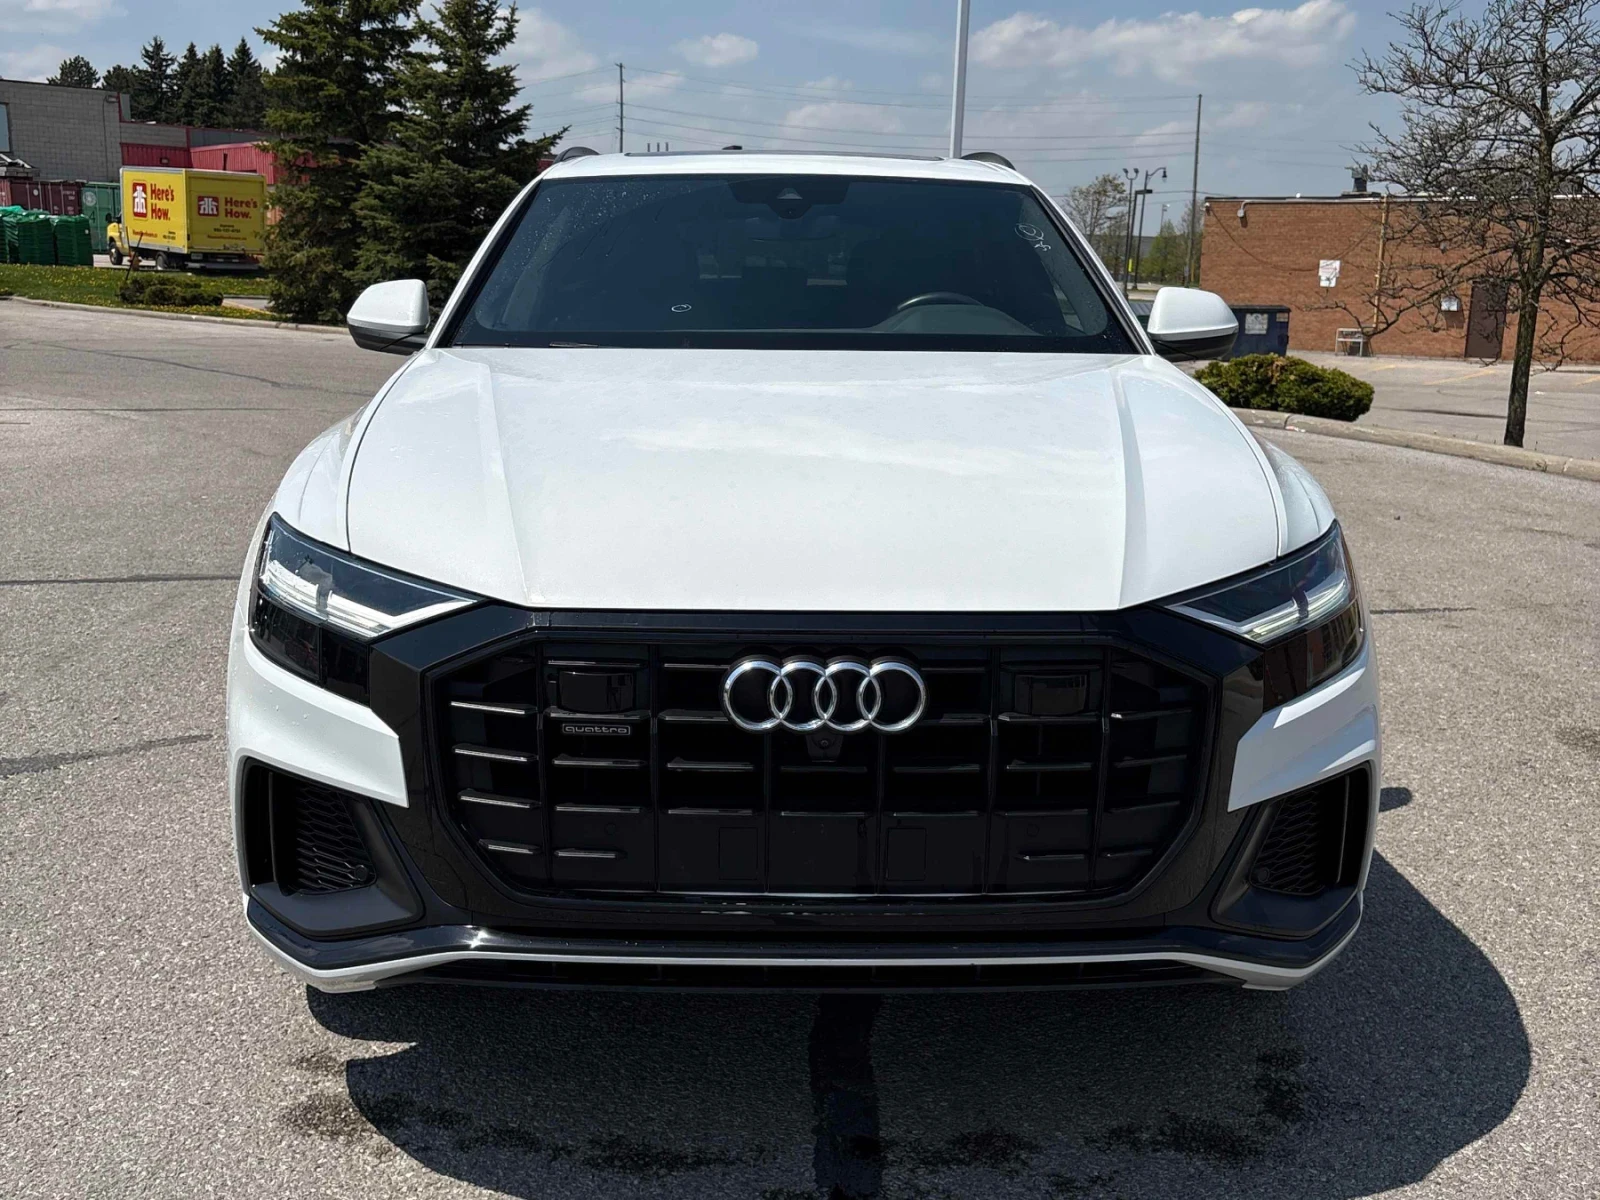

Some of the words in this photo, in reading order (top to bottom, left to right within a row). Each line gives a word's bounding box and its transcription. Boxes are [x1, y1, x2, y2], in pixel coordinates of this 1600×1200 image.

[150, 183, 175, 202] Here's
[224, 197, 258, 209] Here's
[151, 203, 171, 221] How.
[224, 208, 252, 219] How.
[565, 726, 627, 734] quattro
